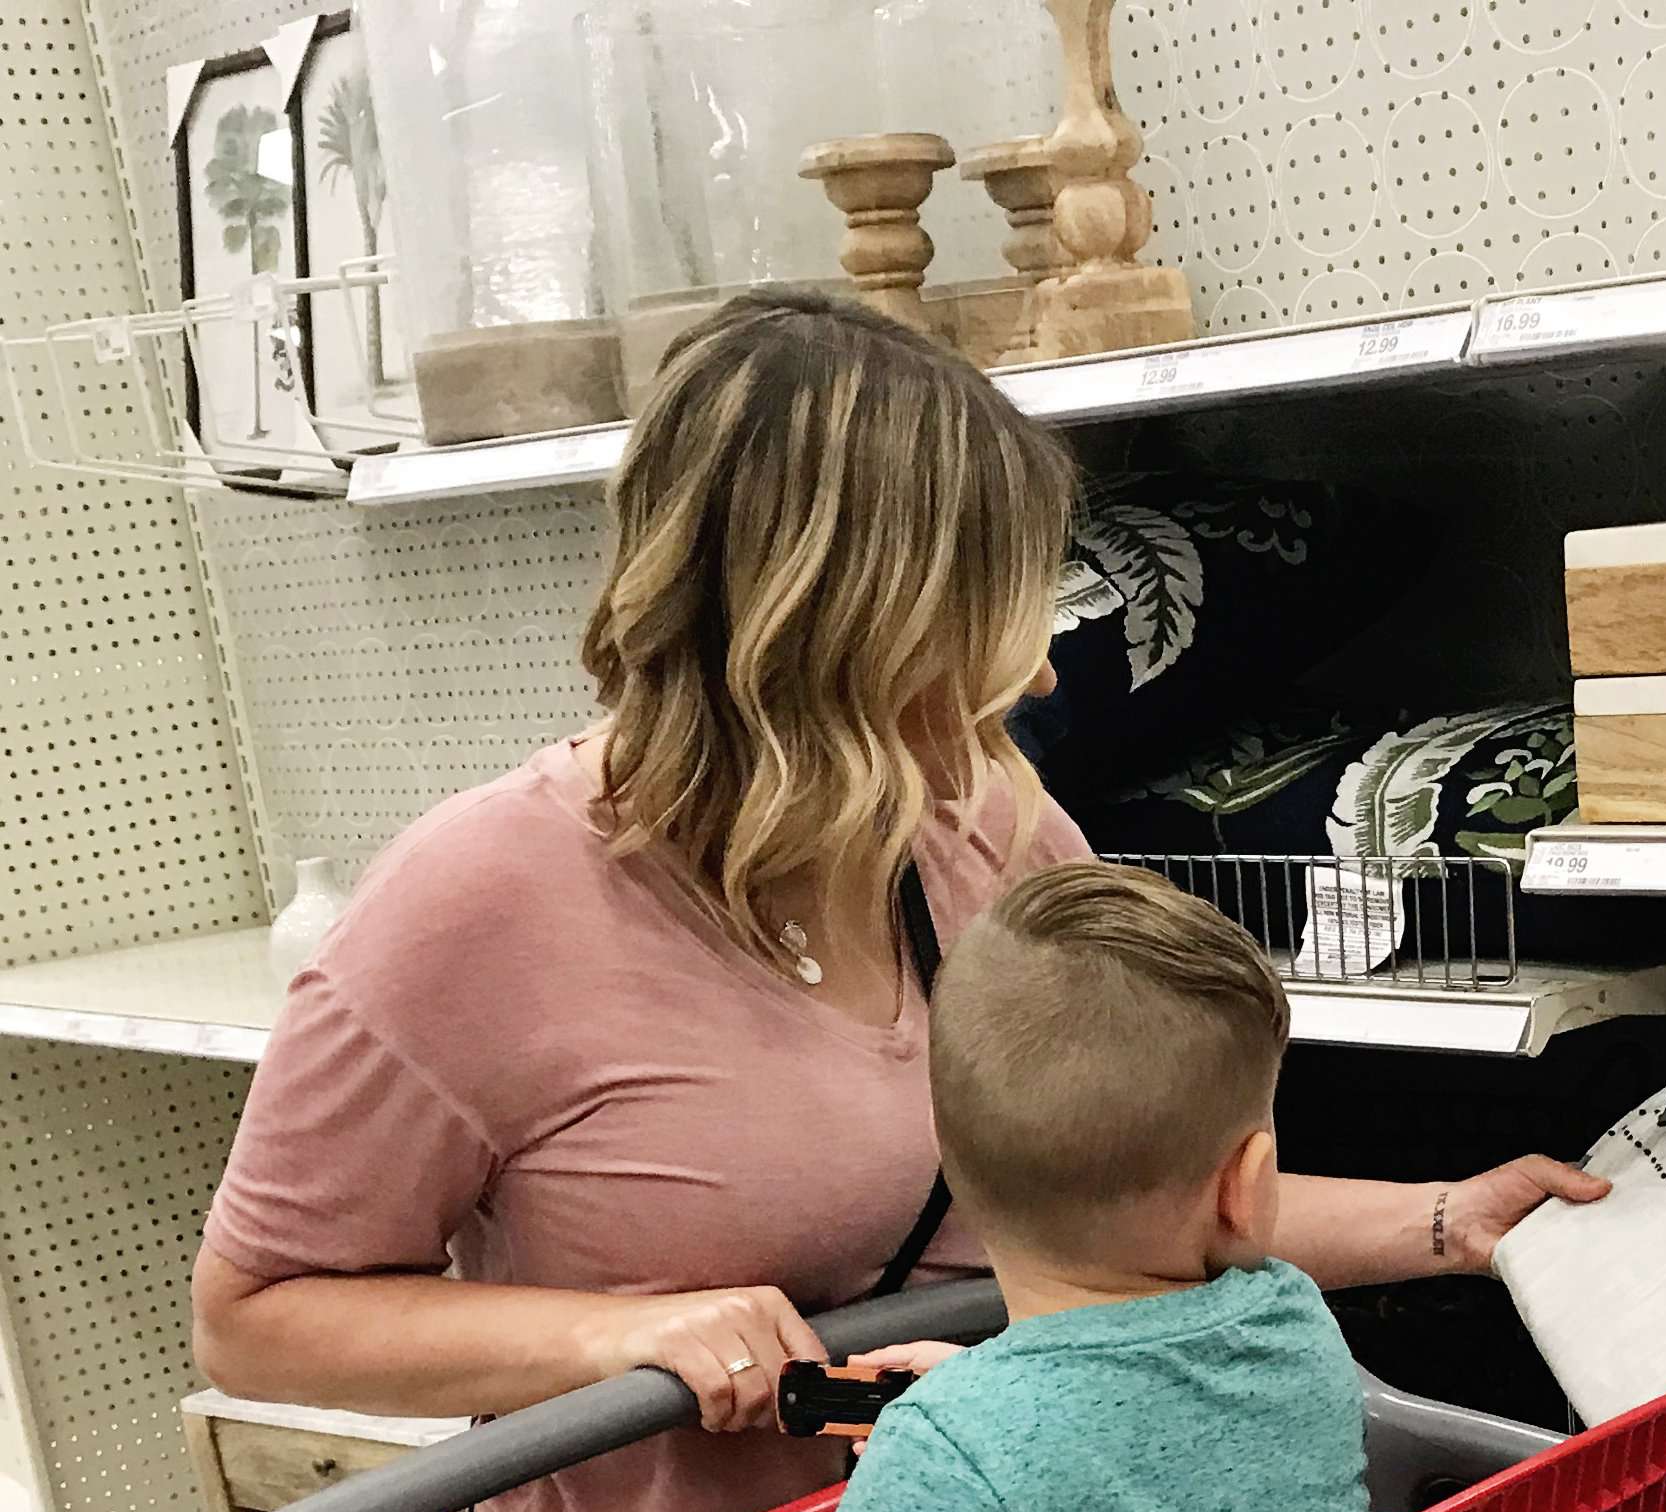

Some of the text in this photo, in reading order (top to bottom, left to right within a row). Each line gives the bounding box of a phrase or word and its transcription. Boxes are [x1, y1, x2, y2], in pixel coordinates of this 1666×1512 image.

[1496, 312, 1541, 332] 16.99
[1358, 336, 1399, 356] 12.99
[1141, 367, 1178, 387] 12.99
